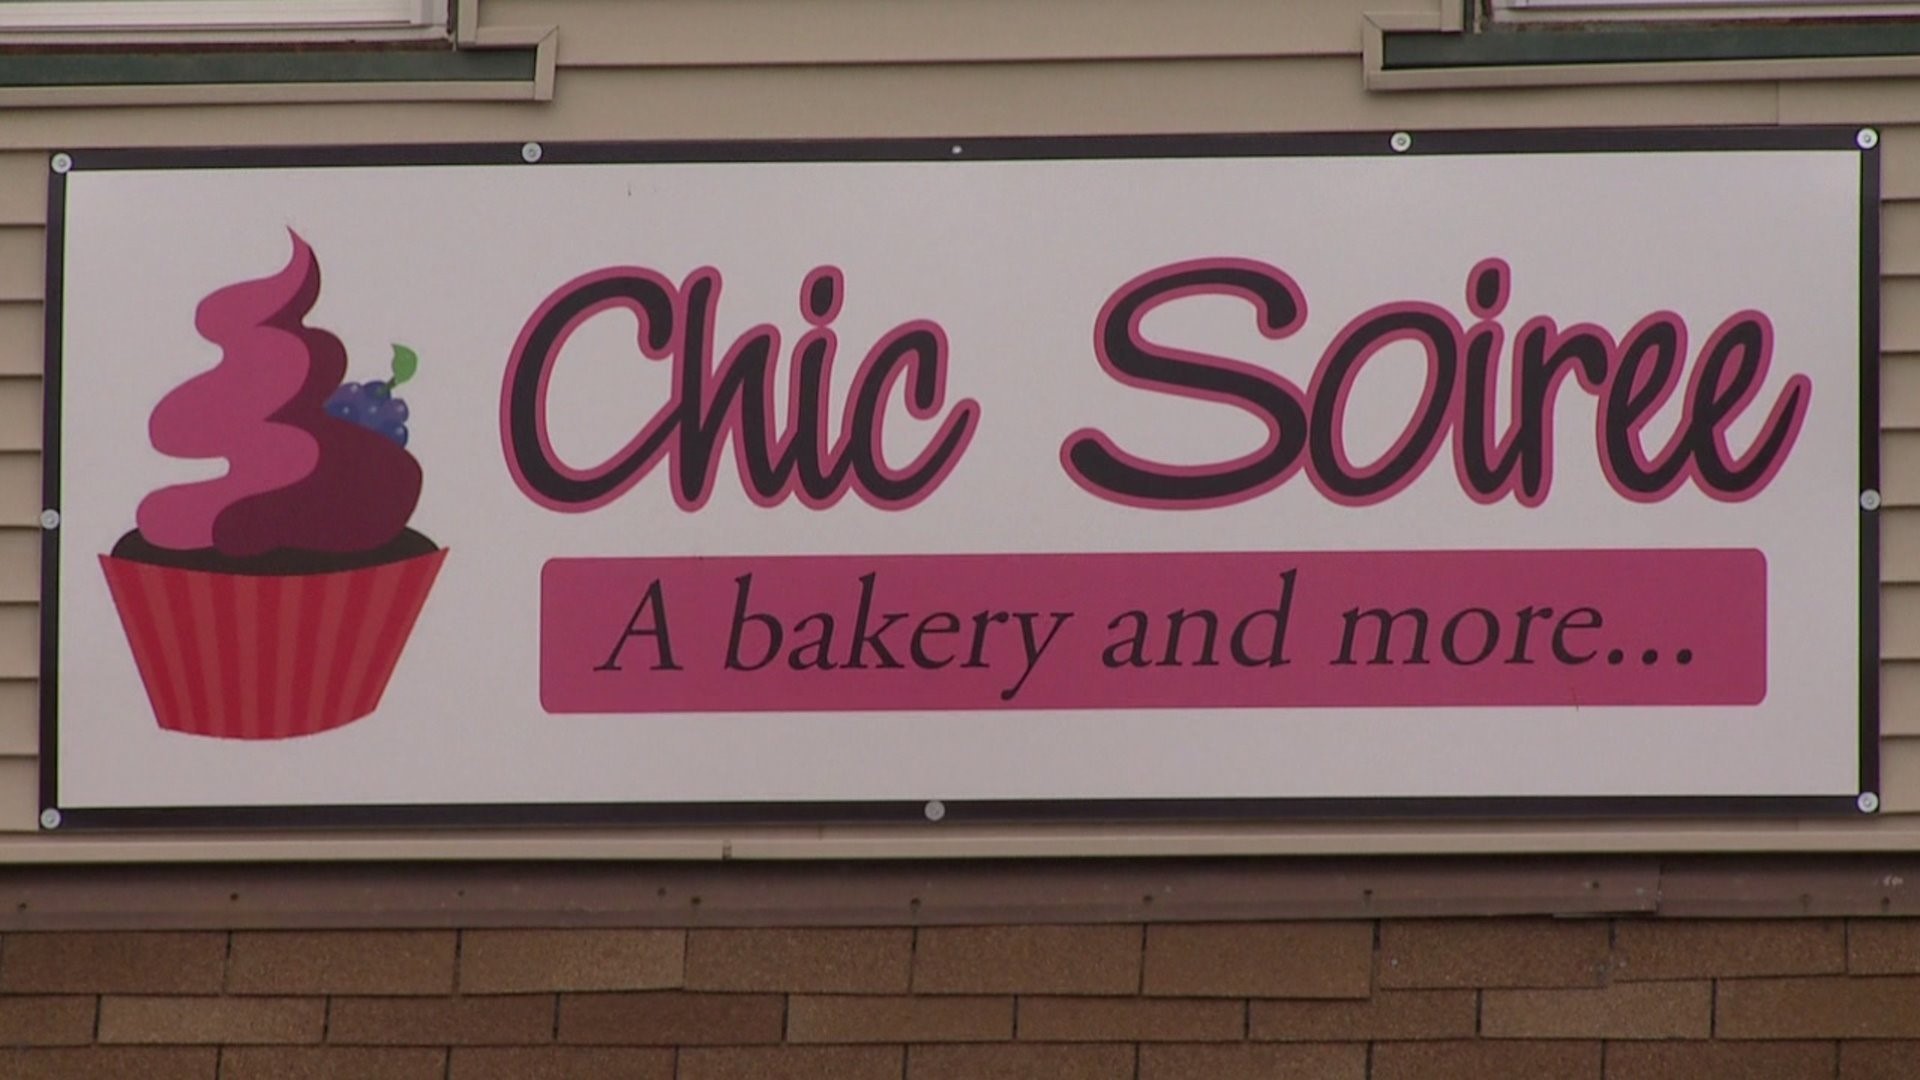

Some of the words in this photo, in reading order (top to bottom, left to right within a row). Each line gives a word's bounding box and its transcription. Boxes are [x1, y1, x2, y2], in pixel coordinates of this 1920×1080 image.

[499, 265, 981, 514] Chic
[594, 579, 683, 671] A
[725, 572, 1074, 701] bakery
[1102, 568, 1297, 668] and
[1330, 606, 1692, 666] more...
